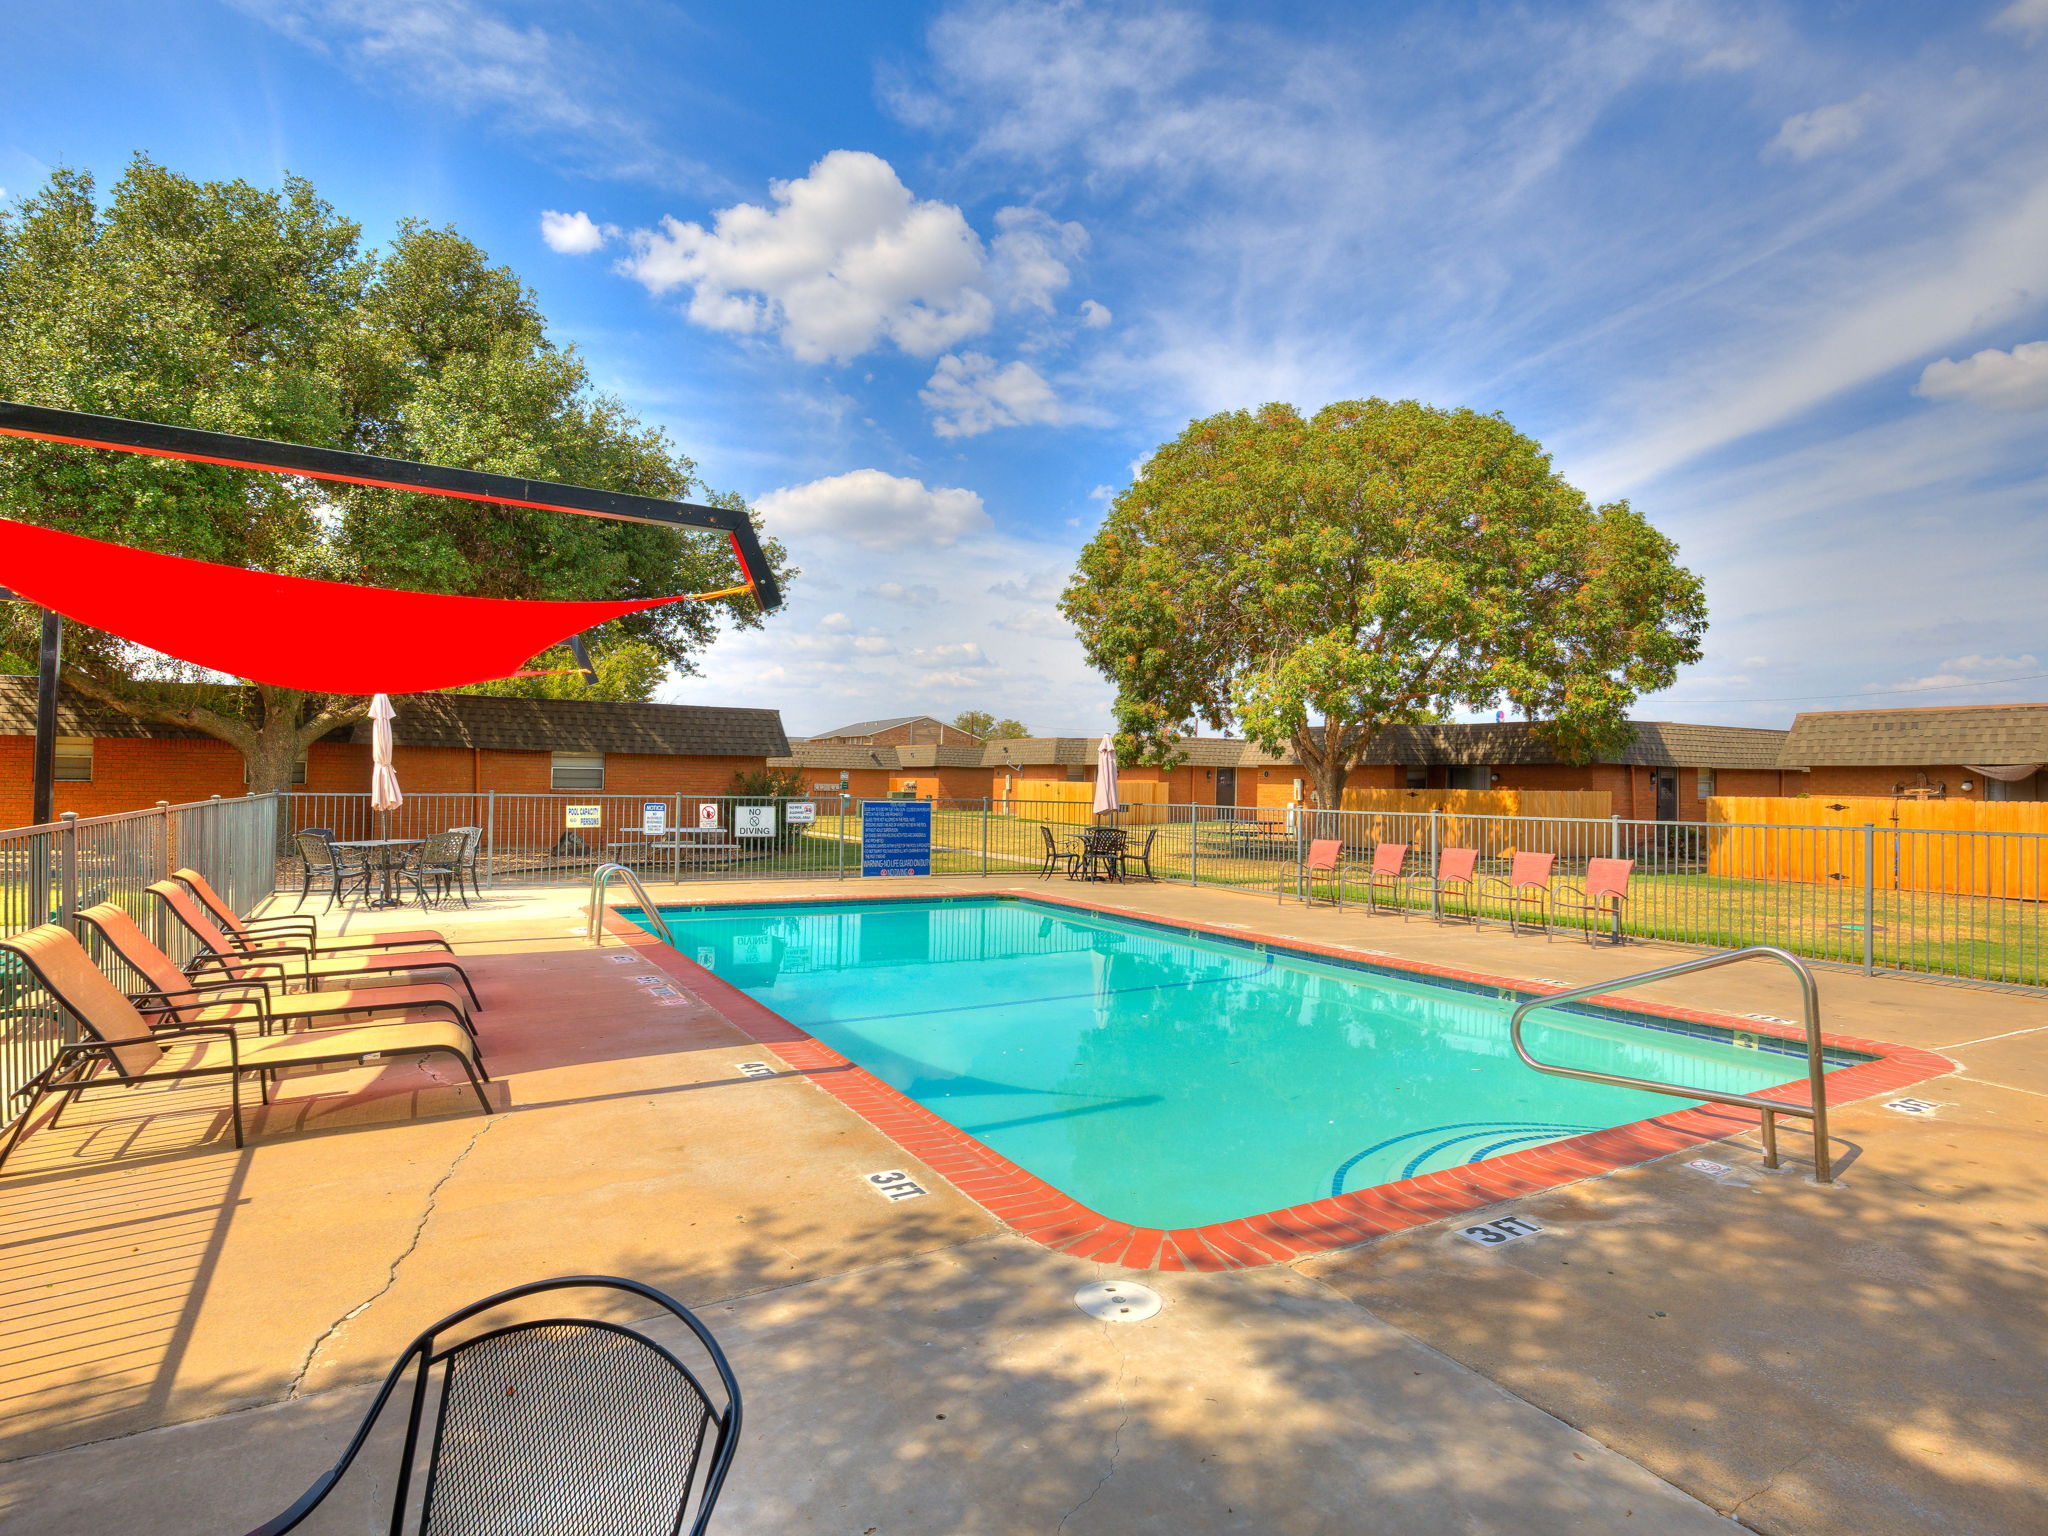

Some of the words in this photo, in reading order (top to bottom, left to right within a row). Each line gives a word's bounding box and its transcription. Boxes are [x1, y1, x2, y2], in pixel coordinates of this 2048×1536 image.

[580, 807, 599, 815] CAPACITY
[748, 808, 761, 816] NO
[580, 817, 599, 825] PERSONS
[739, 827, 770, 835] DIVING
